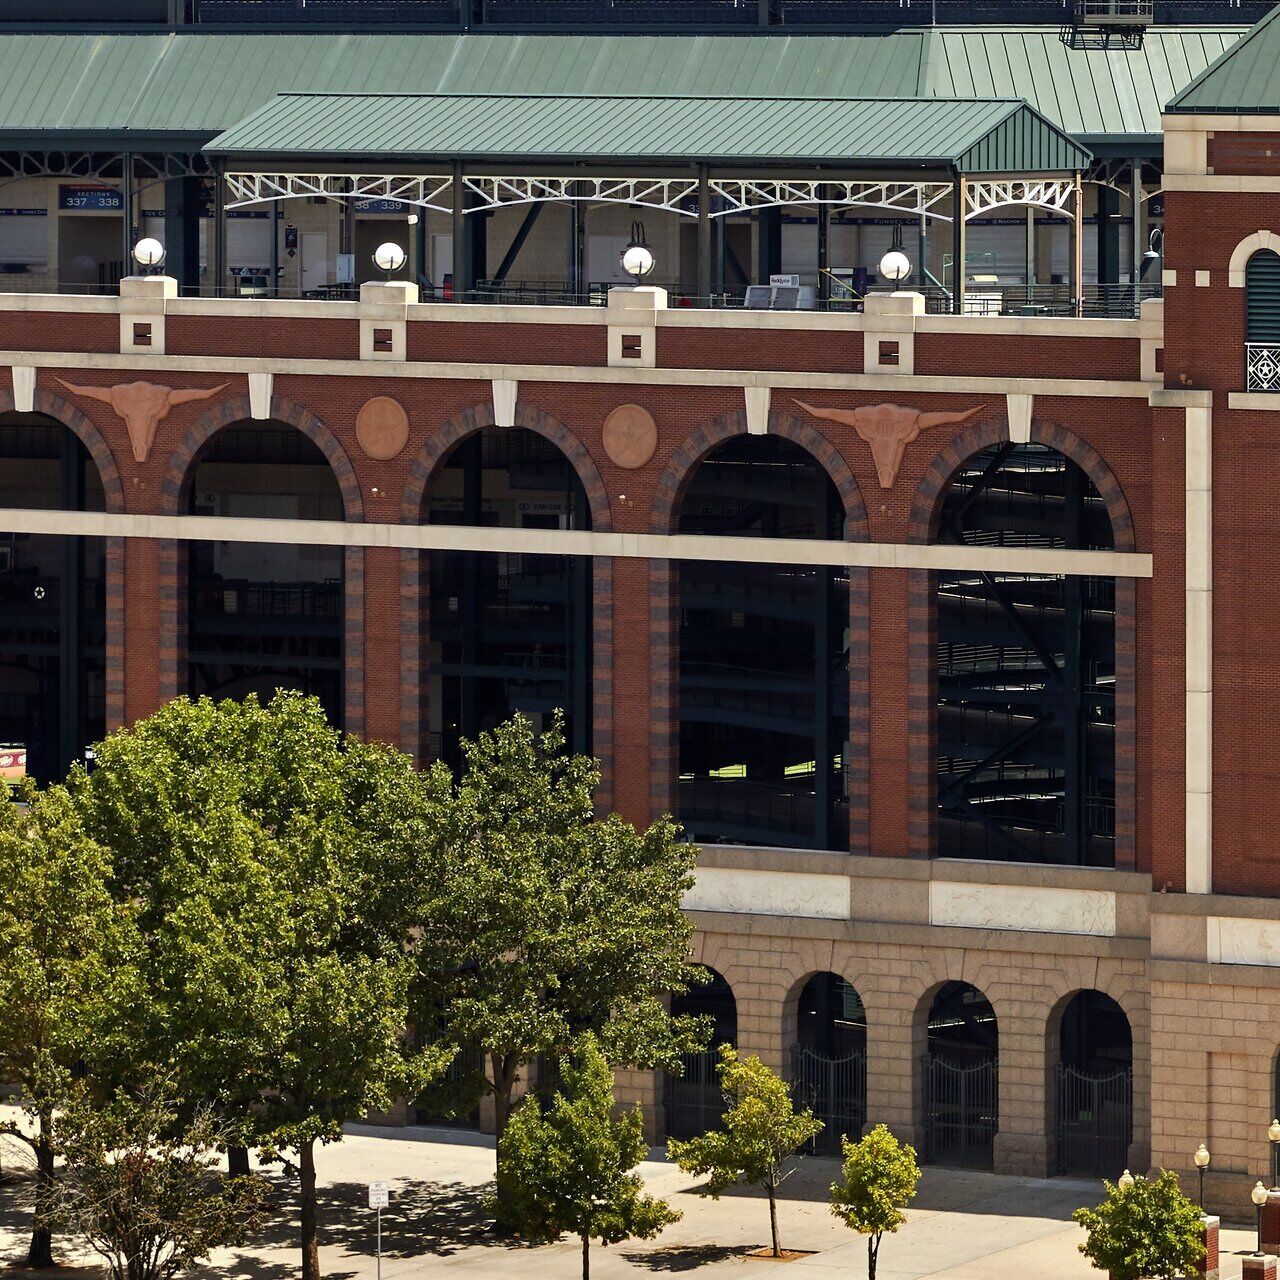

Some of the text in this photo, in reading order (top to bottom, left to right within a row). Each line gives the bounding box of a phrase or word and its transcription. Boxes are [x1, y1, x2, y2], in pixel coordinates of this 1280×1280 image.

[67, 197, 119, 206] 337 338
[381, 201, 402, 210] 339
